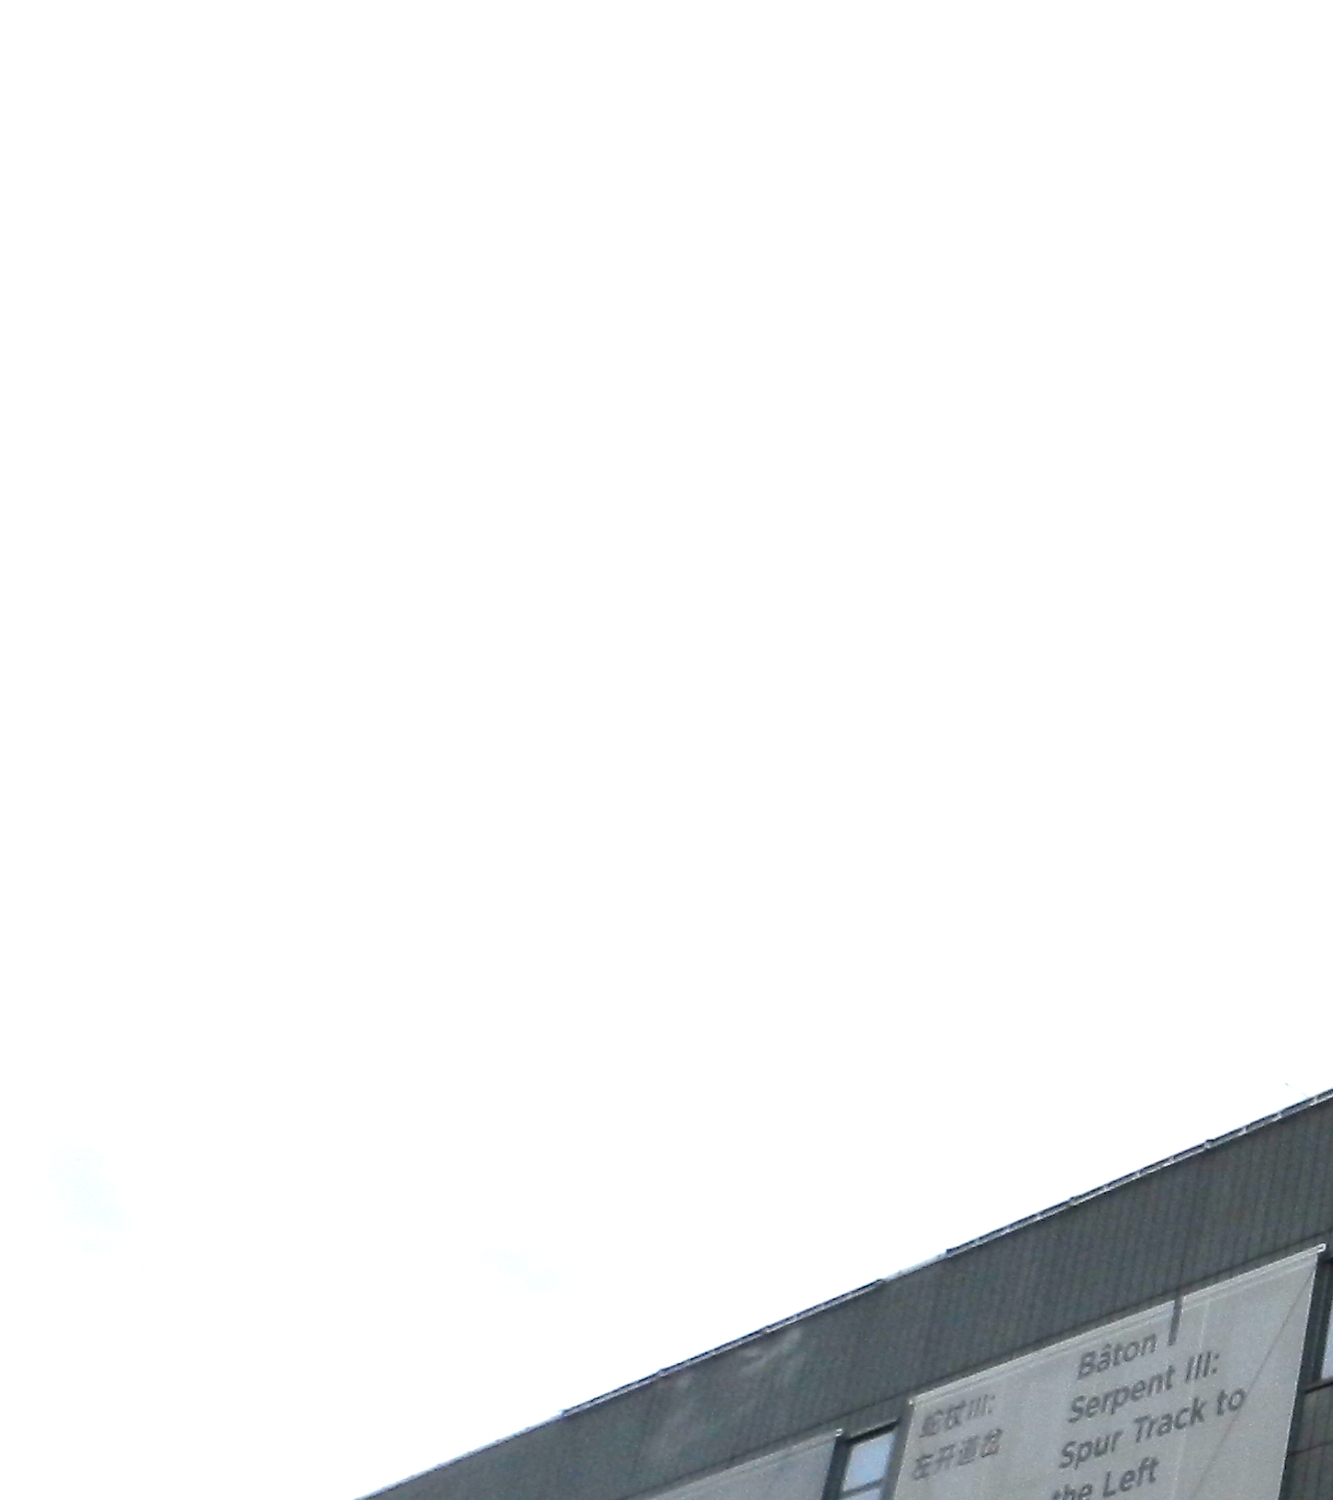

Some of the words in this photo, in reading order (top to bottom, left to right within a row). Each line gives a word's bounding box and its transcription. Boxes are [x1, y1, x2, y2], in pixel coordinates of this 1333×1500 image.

[1077, 1332, 1157, 1381] Bâton
[1068, 1367, 1175, 1424] Serpent
[1058, 1431, 1124, 1470] Spur
[1132, 1396, 1207, 1445] Track
[1215, 1386, 1246, 1414] to
[1103, 1456, 1160, 1499] Left
